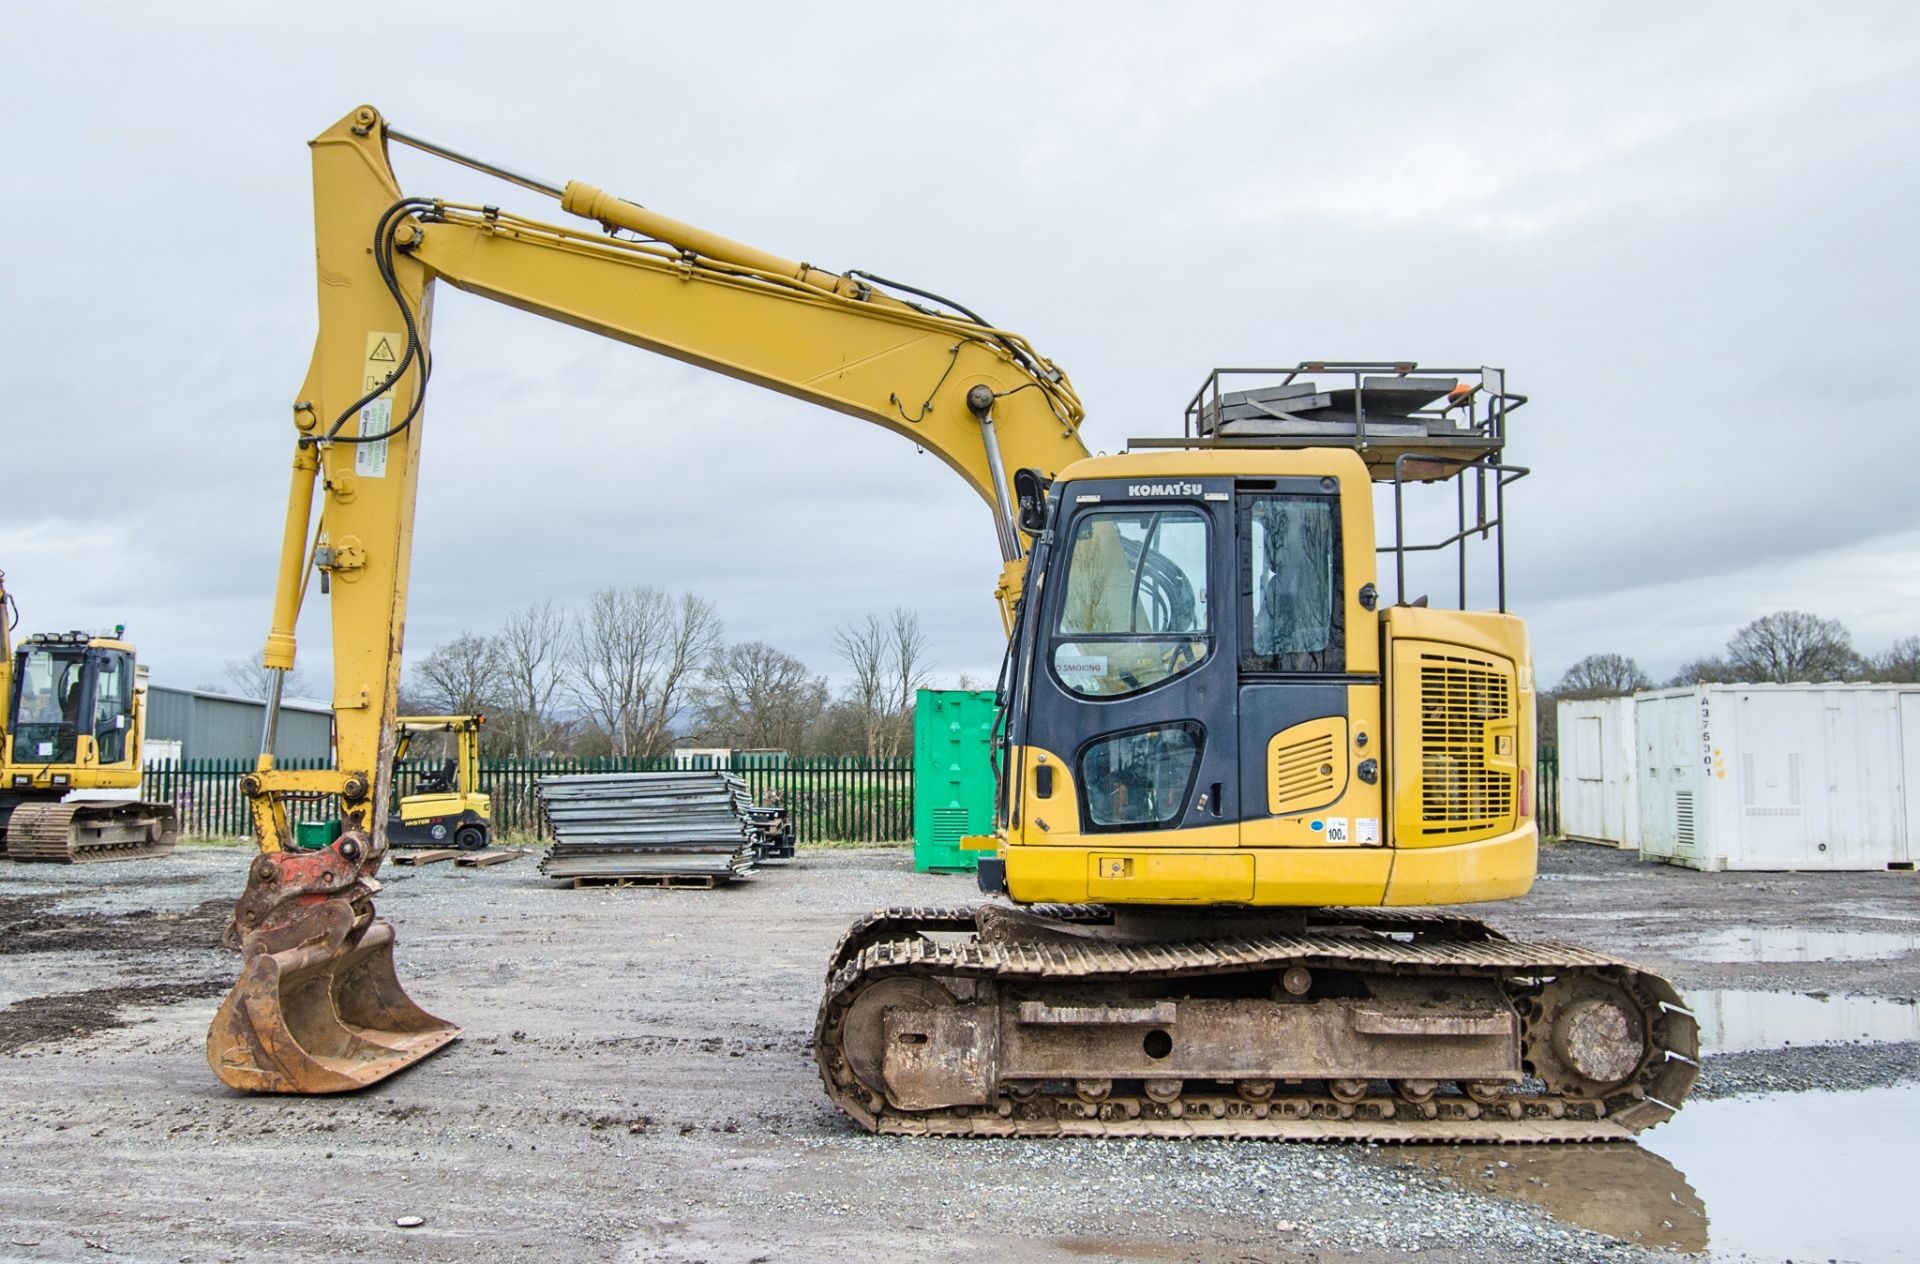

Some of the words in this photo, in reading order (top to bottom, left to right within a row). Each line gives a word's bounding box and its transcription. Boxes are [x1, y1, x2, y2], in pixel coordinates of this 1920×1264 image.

[1129, 481, 1202, 497] KOMATSU
[1063, 664, 1101, 672] SMOKING
[1701, 697, 1711, 777] A375301
[1328, 828, 1342, 840] 100
